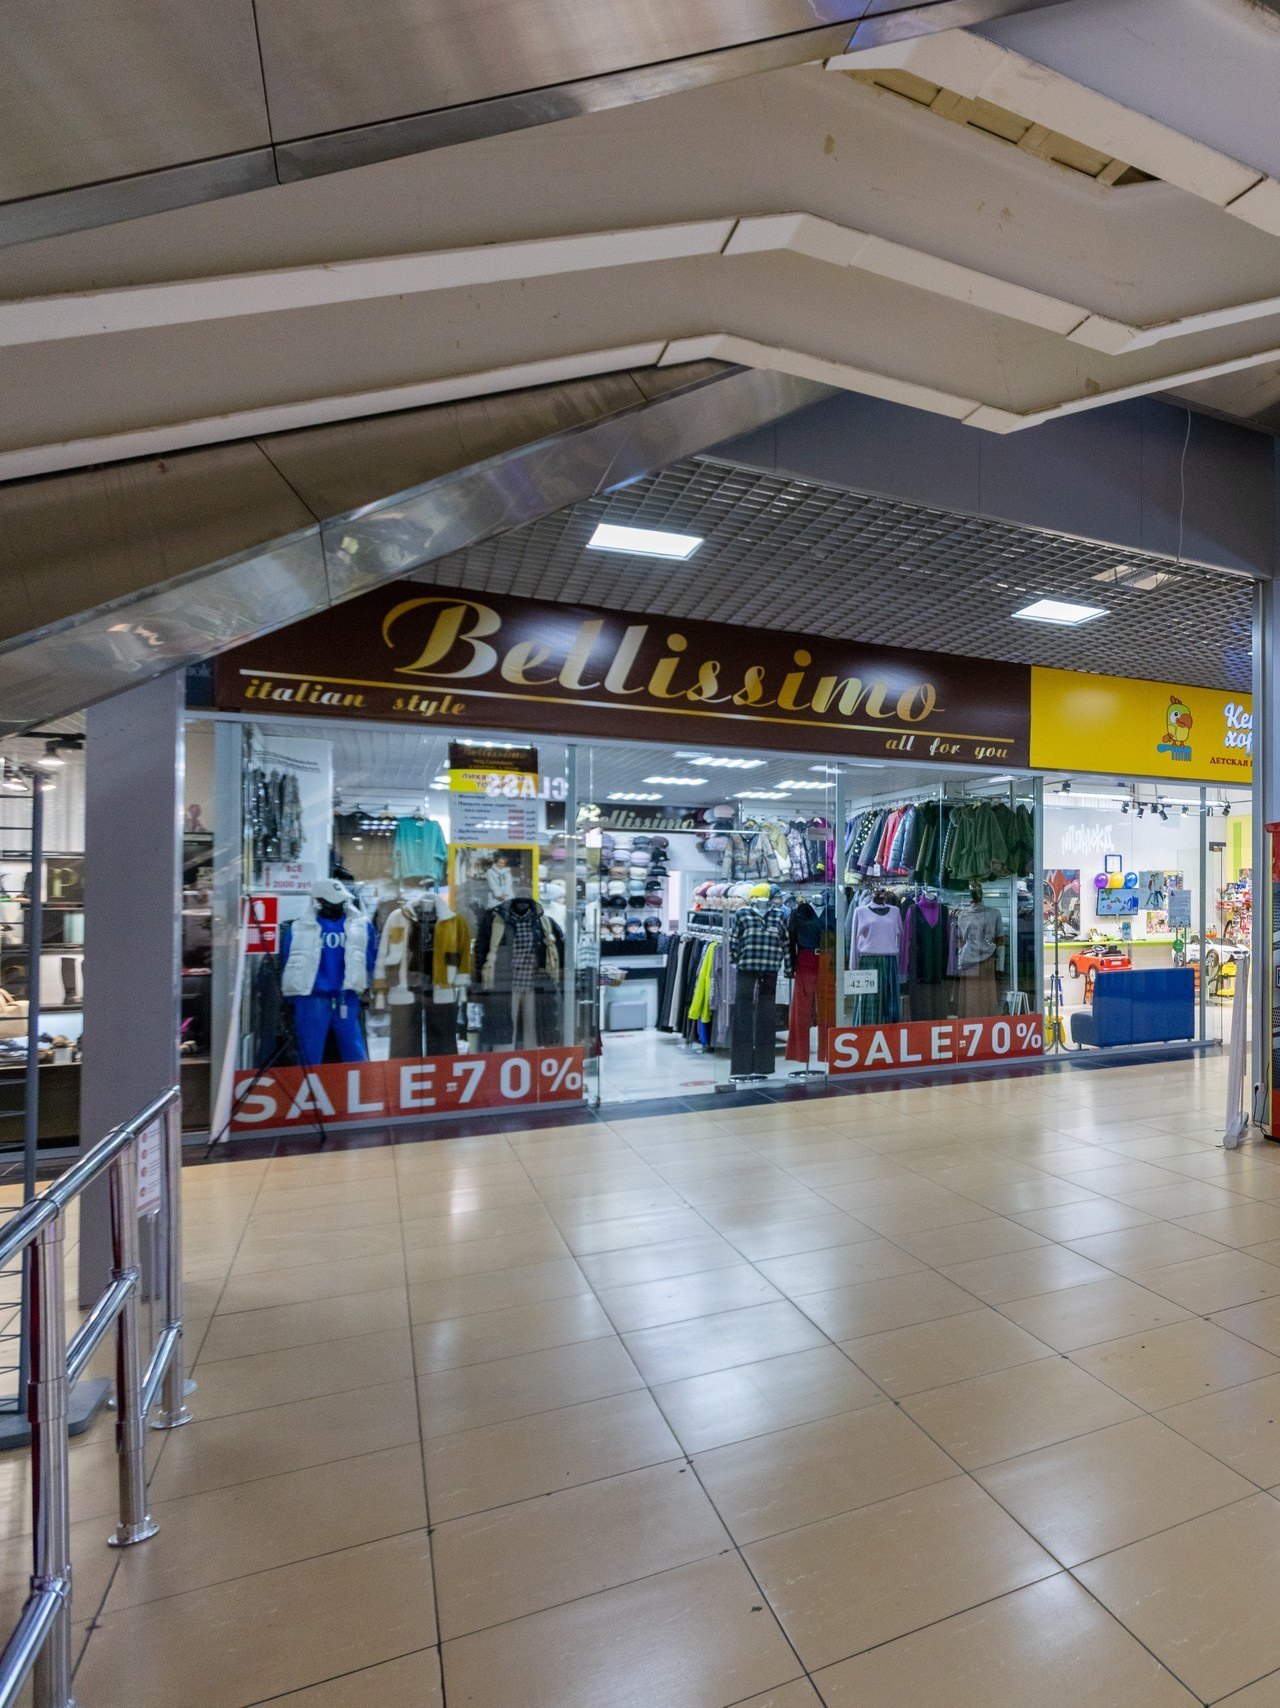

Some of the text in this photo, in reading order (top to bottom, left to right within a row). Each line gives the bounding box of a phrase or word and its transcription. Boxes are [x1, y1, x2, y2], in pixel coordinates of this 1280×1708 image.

[382, 597, 945, 722] Bellissimo
[244, 679, 466, 717] italian style
[1223, 702, 1252, 730] Ке
[886, 735, 1009, 759] all for you
[1210, 756, 1249, 767] ДЕТСКАЯ
[833, 1025, 953, 1068] SALE
[234, 1063, 436, 1123] SALE
